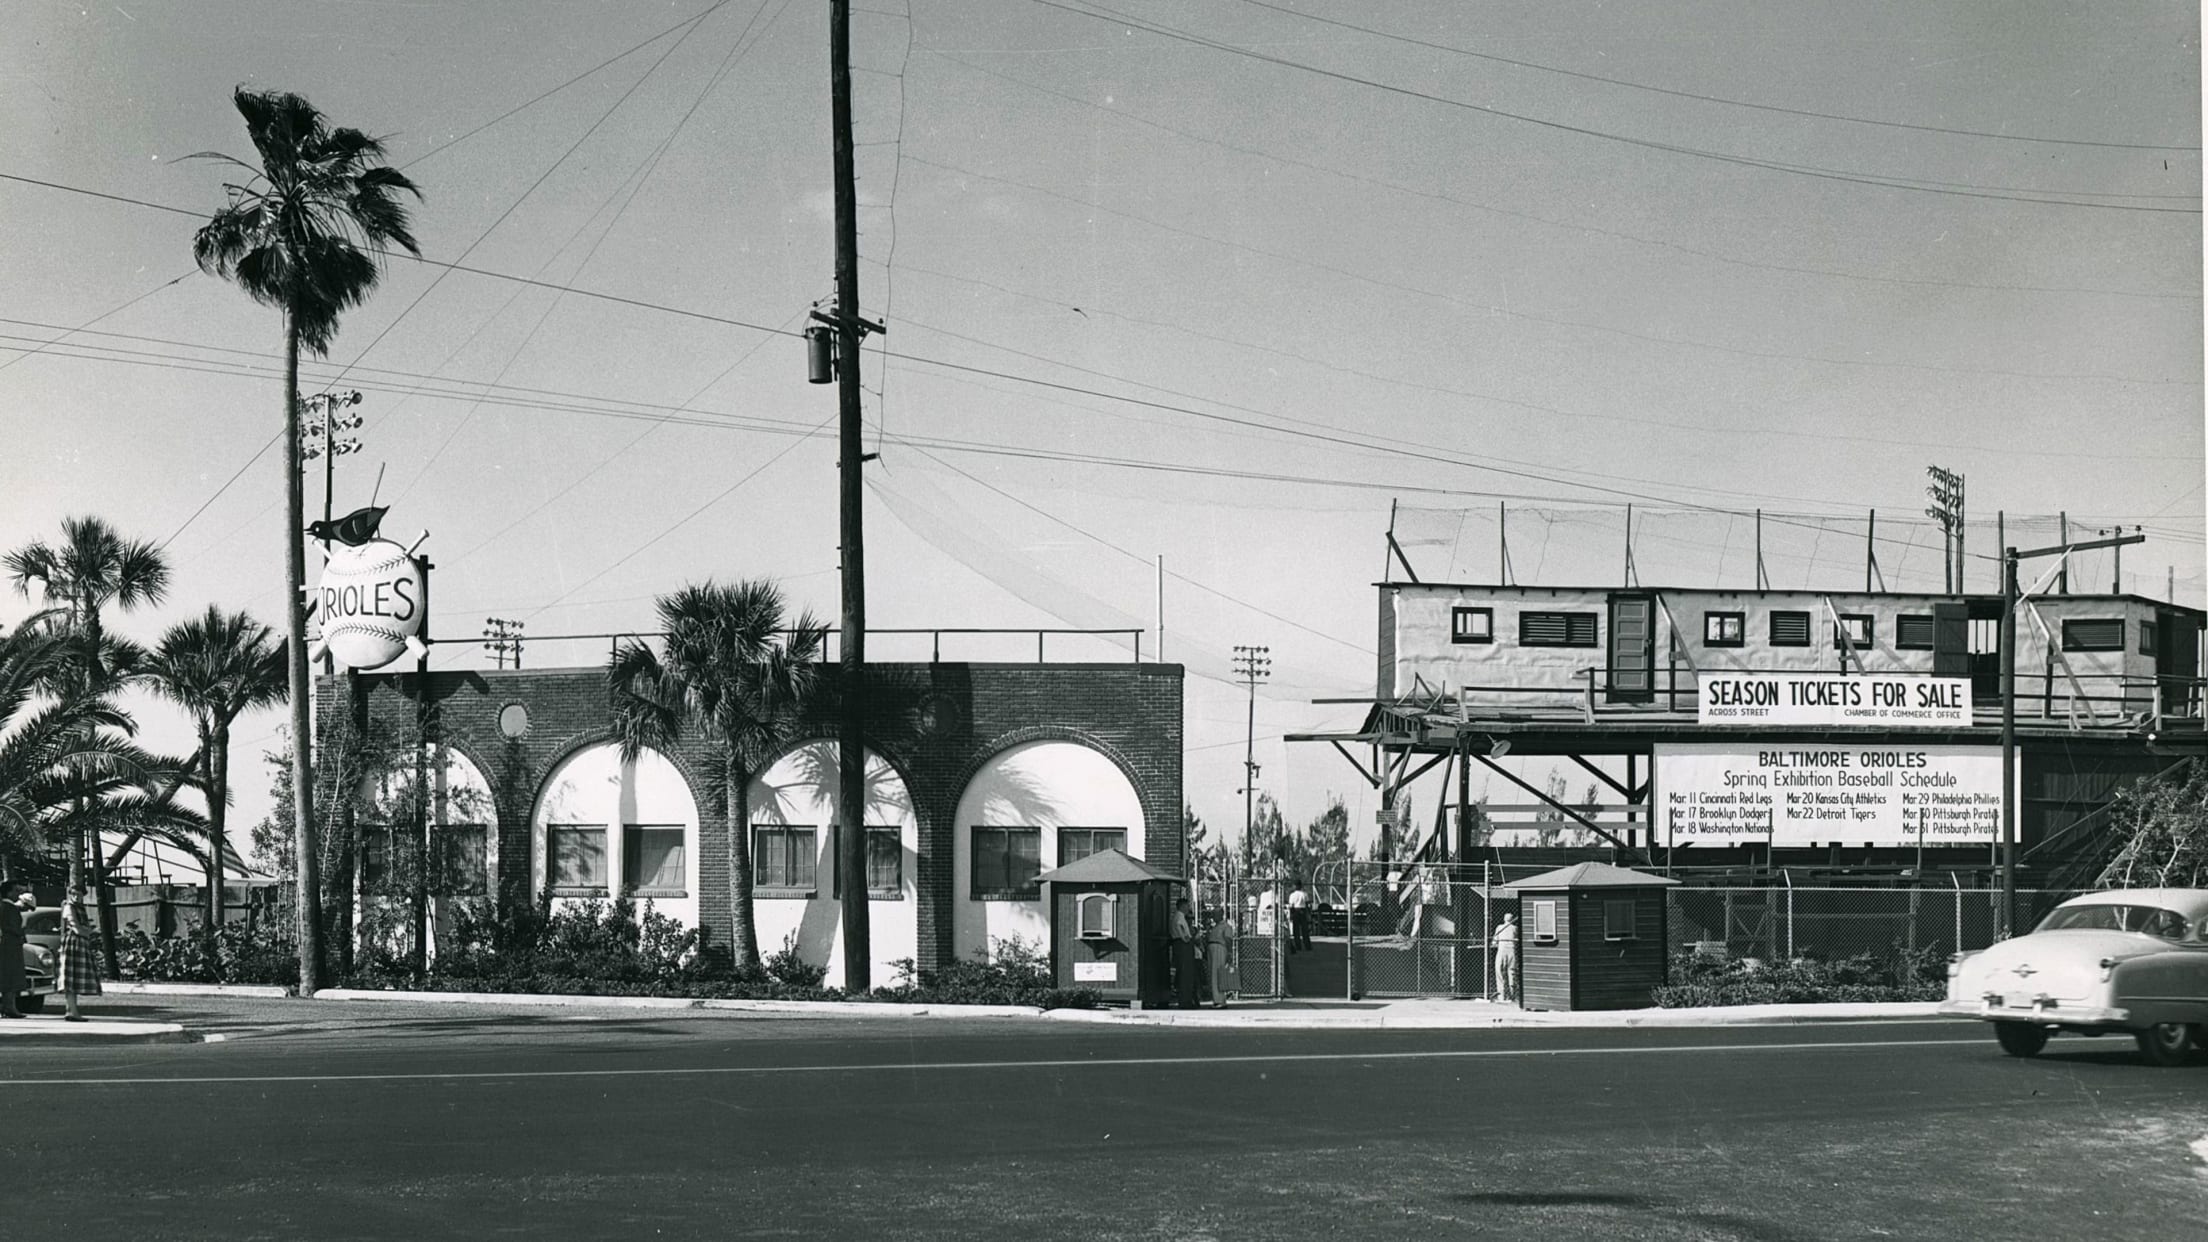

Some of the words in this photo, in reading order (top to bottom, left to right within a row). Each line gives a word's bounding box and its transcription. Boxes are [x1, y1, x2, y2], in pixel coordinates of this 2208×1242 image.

[318, 577, 415, 626] ORIOLES
[1708, 681, 1779, 706] SEASON
[1788, 681, 1861, 706] TICKETS
[1872, 682, 1906, 707] FOR
[1918, 683, 1962, 709] SALE
[1708, 709, 1737, 717] ACROSS
[1741, 709, 1769, 717] STREET
[1844, 709, 1877, 717] CHAMBER
[1892, 710, 1932, 719] COMMERCE
[1936, 711, 1961, 719] OFFICE
[1759, 751, 1850, 767] BALTIMORE
[1860, 752, 1927, 768] ORIOLES
[1723, 770, 1767, 789] Spring
[1774, 770, 1832, 786] Exhibition
[1839, 770, 1893, 787] Baseball
[1900, 771, 1957, 787] Schedule
[1690, 792, 1696, 804] 11
[1699, 792, 1737, 804] Cincinnati
[1740, 792, 1754, 804] Red
[1756, 792, 1772, 806] Legs
[1802, 792, 1814, 804] 20
[1815, 792, 1839, 804] Kansas
[1840, 792, 1854, 806] City
[1855, 792, 1887, 804] Athletics
[1918, 792, 1930, 805] 29
[1931, 793, 1972, 806] Philadelphia
[1973, 793, 2000, 805] Phillies
[1688, 807, 1697, 819] 17
[1699, 807, 1737, 821] Brooklyn
[1803, 807, 1814, 819] 22
[1816, 807, 1846, 820] Detroit
[1850, 807, 1877, 822] Tigers
[1932, 808, 1971, 821] Pittsburgh
[1688, 822, 1697, 834] 18
[1699, 822, 1744, 836] Washington
[1932, 822, 1971, 836] Pittsburgh
